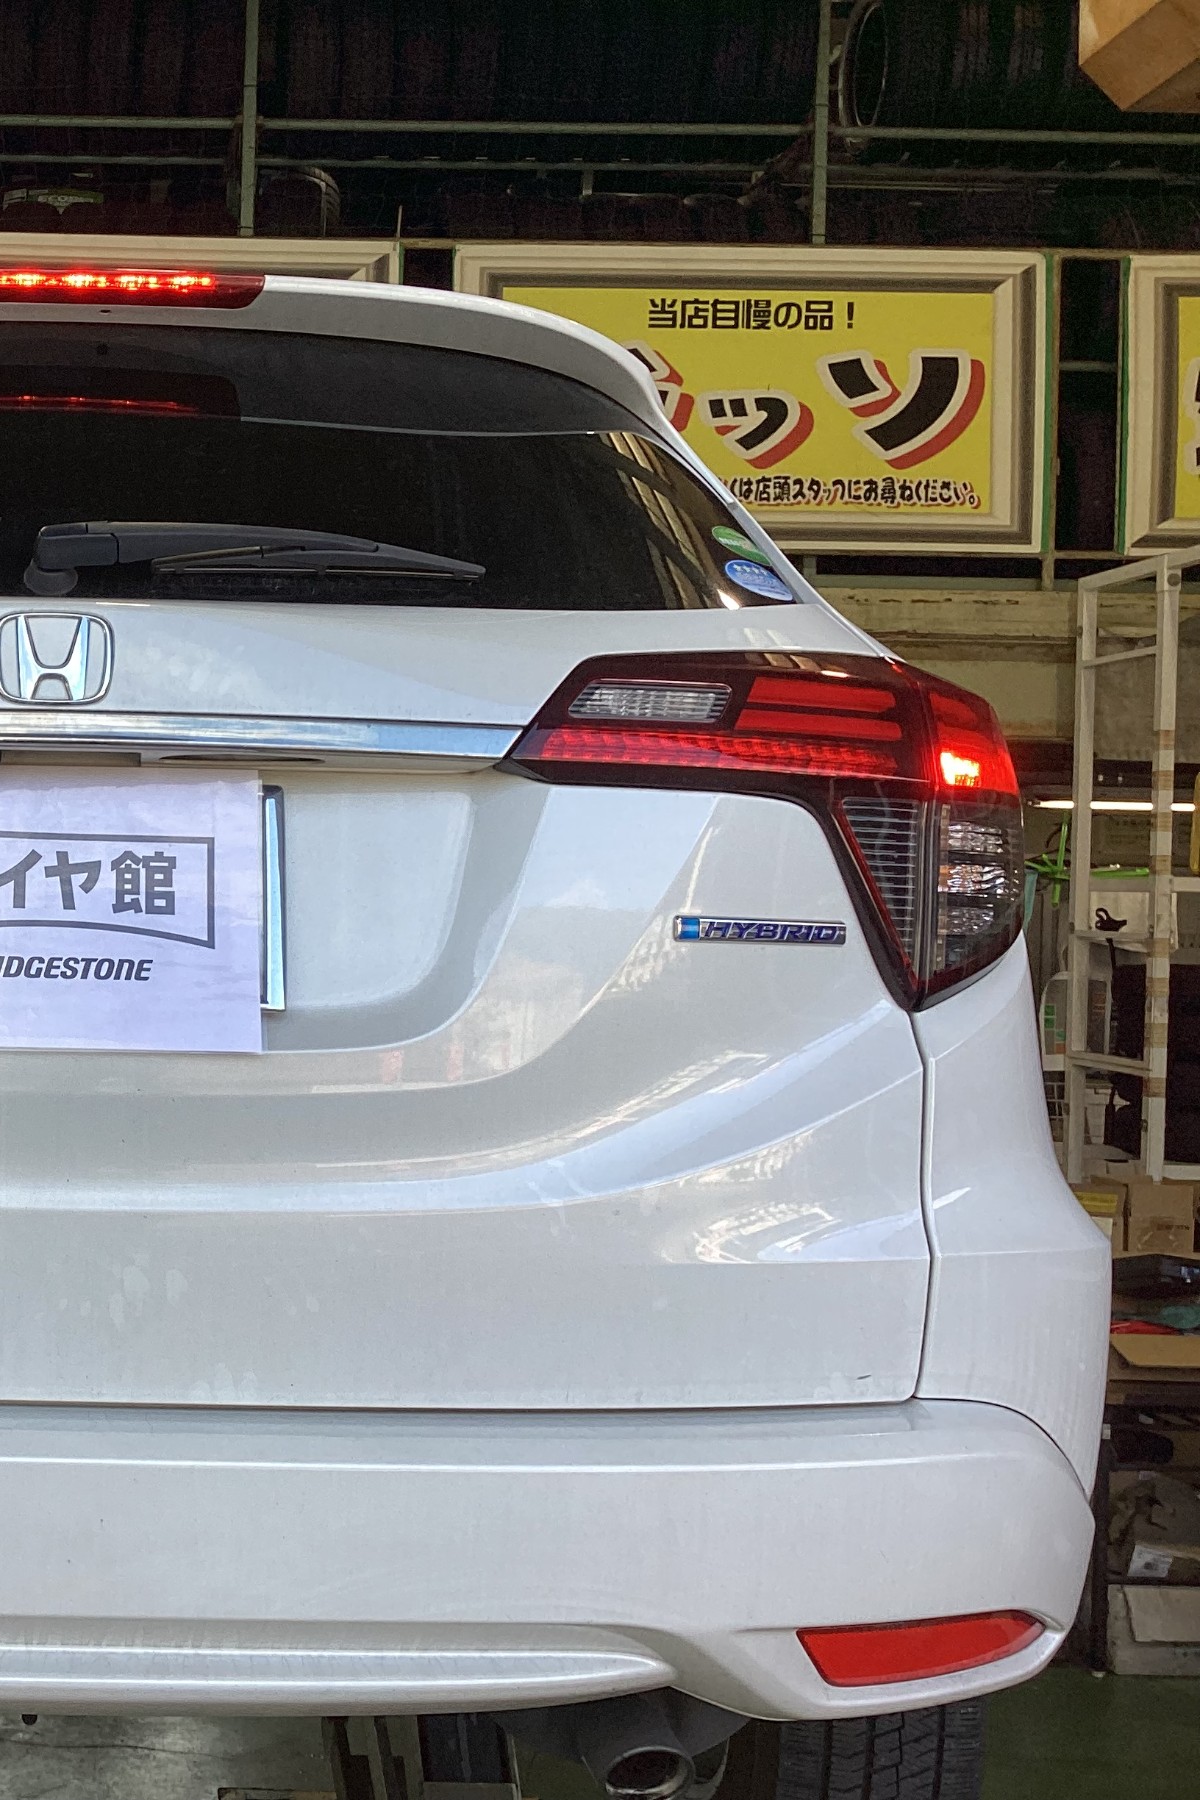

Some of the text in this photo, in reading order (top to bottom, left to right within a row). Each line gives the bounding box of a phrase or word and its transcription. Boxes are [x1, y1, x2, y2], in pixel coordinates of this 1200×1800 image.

[648, 298, 855, 331] 当店自慢の品！
[703, 920, 842, 943] HYBRID
